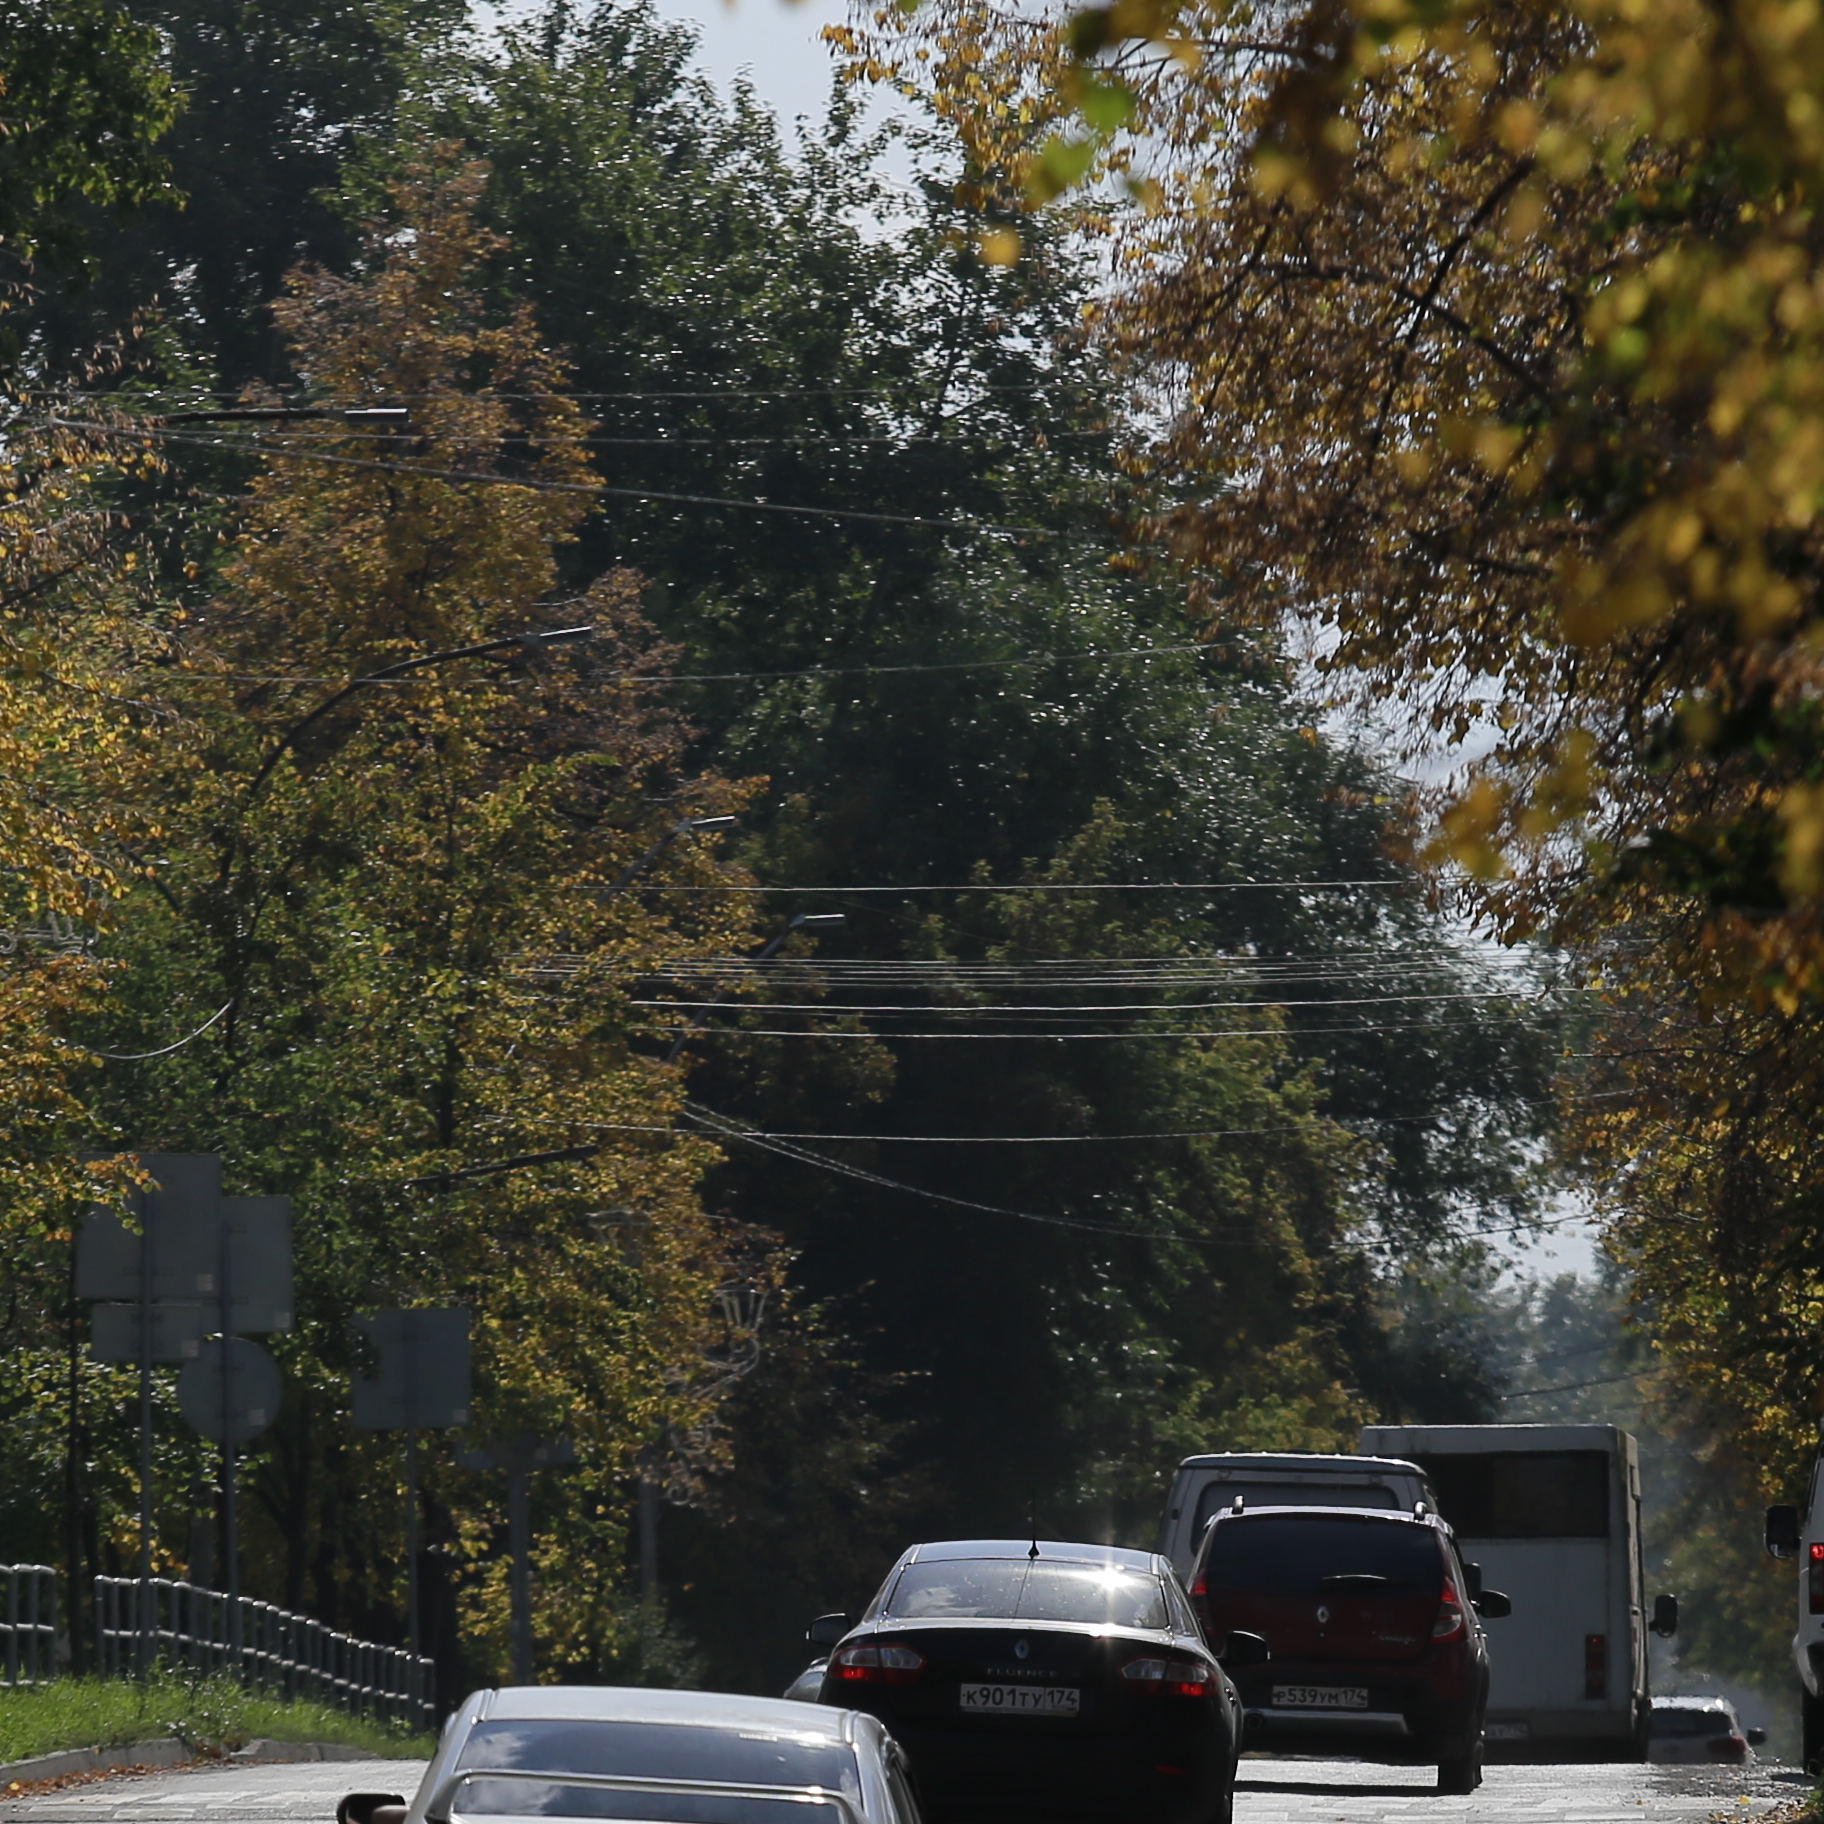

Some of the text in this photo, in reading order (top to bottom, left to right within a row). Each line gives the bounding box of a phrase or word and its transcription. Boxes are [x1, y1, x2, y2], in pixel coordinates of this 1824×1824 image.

[965, 1687, 1077, 1707] К901ТУ 174
[1341, 1689, 1366, 1702] 174
